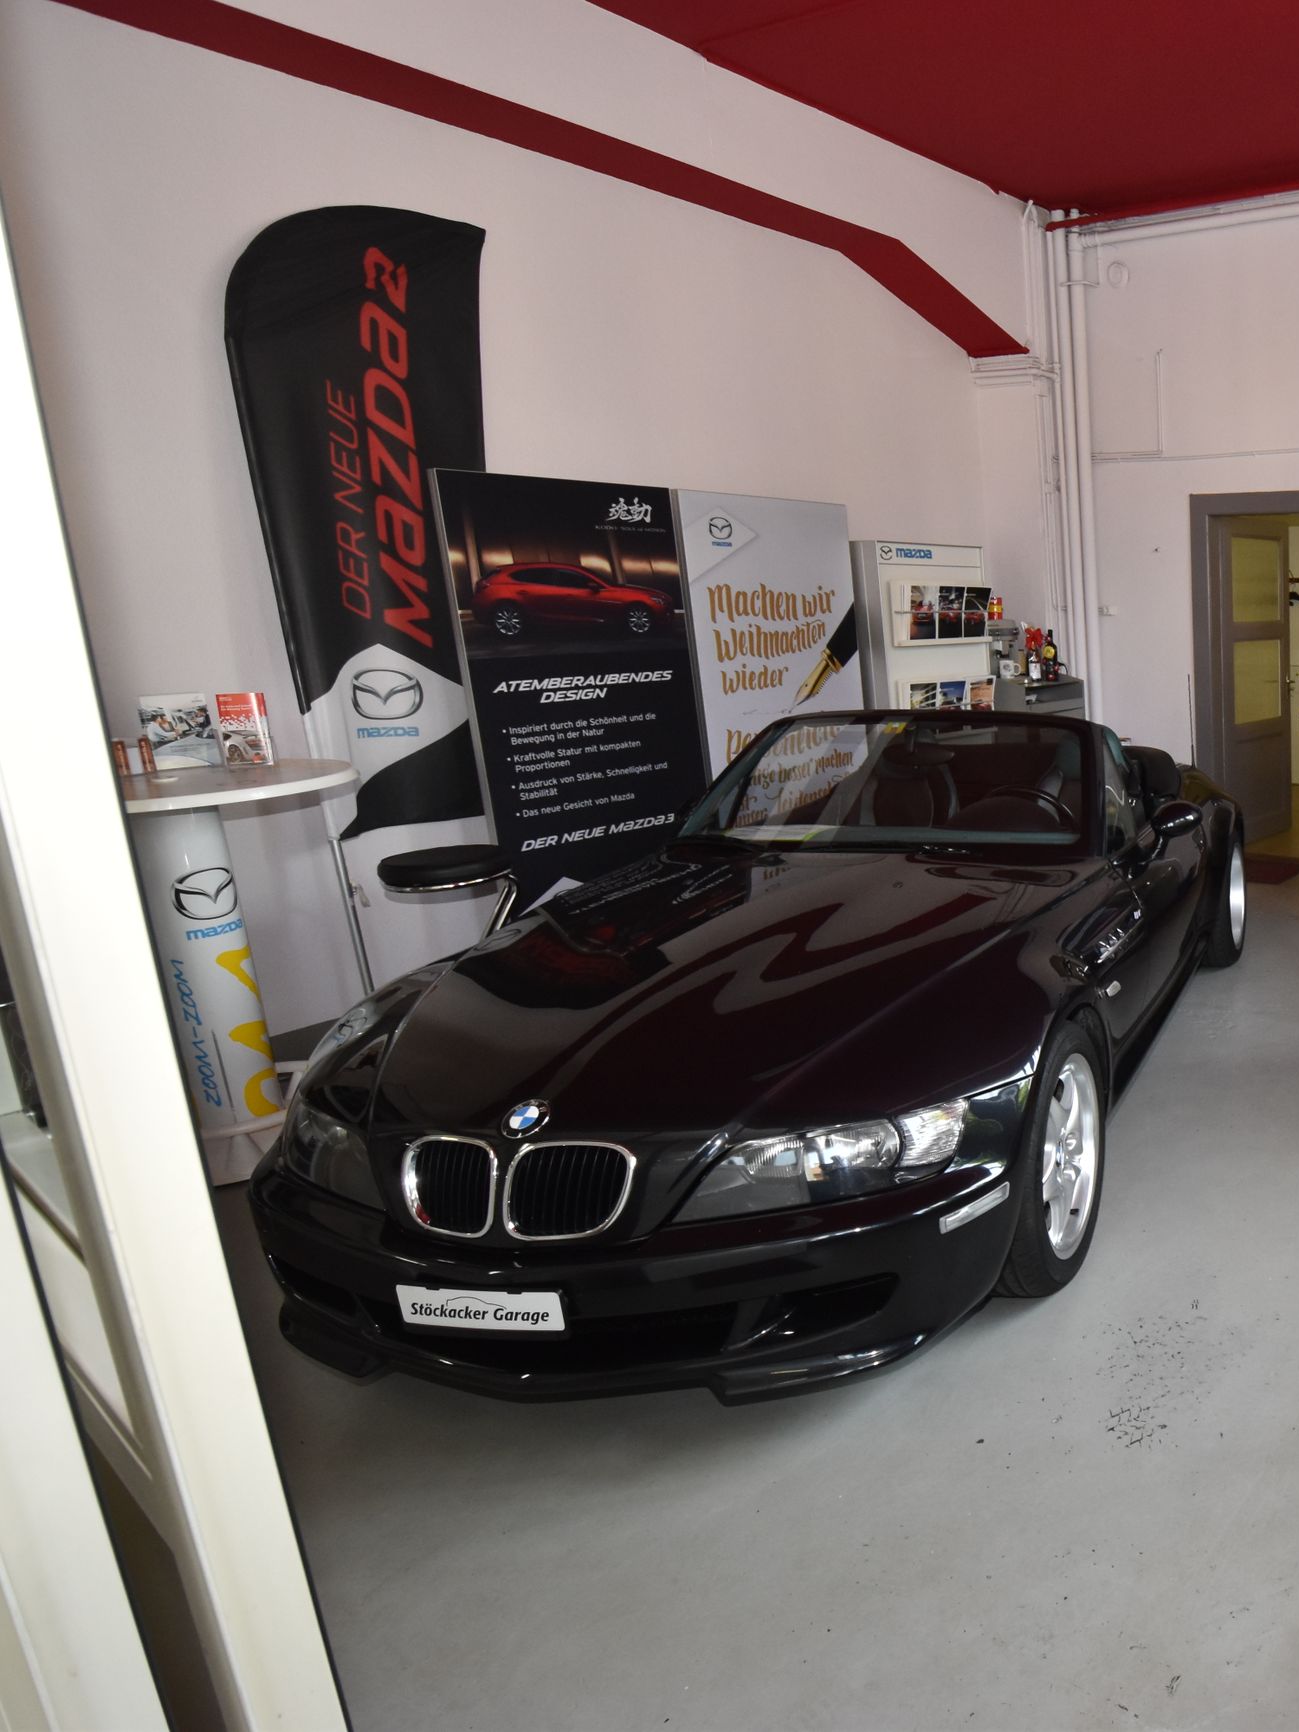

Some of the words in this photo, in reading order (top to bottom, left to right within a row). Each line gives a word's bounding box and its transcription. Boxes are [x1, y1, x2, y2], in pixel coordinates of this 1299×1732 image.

[327, 379, 364, 513] NEUE
[896, 548, 932, 559] mazda
[337, 520, 371, 620] DER
[707, 582, 799, 623] Machen
[801, 585, 835, 618] wir
[713, 619, 826, 663] Weihnachten
[493, 670, 673, 693] ATEMBERAUBENDES
[721, 664, 789, 695] wieder
[540, 688, 607, 703] DESIGN
[357, 727, 419, 739] mazda
[509, 723, 547, 736] Inspiriert
[550, 721, 573, 731] durch
[575, 719, 588, 728] die
[589, 715, 628, 727] Schönheit
[629, 714, 643, 722] und
[645, 712, 656, 720] die
[511, 732, 555, 745] Bewegung
[556, 732, 565, 740] in
[566, 730, 580, 739] der
[582, 728, 605, 737] Natur
[513, 751, 555, 763] Kraftvolle
[557, 748, 582, 758] Statur
[585, 745, 598, 753] mit
[600, 740, 641, 752] kompakten
[515, 759, 570, 773] Proportionen
[518, 779, 558, 790] Ausdruck
[560, 775, 575, 784] von
[576, 771, 604, 783] Stärke,
[606, 764, 652, 777] Schnelligkeit
[654, 762, 668, 770] und
[520, 788, 558, 801] Stabilität
[522, 809, 539, 818] Das
[541, 806, 561, 815] neue
[563, 800, 593, 811] Gesicht
[595, 797, 609, 806] von
[611, 792, 635, 802] Mazda
[521, 835, 558, 851] DER
[561, 826, 607, 844] NEUE
[186, 918, 244, 940] mazda
[169, 959, 222, 1107] ZOOM-ZOOM
[410, 1302, 488, 1321] Stöckacker
[493, 1307, 550, 1325] Garage
